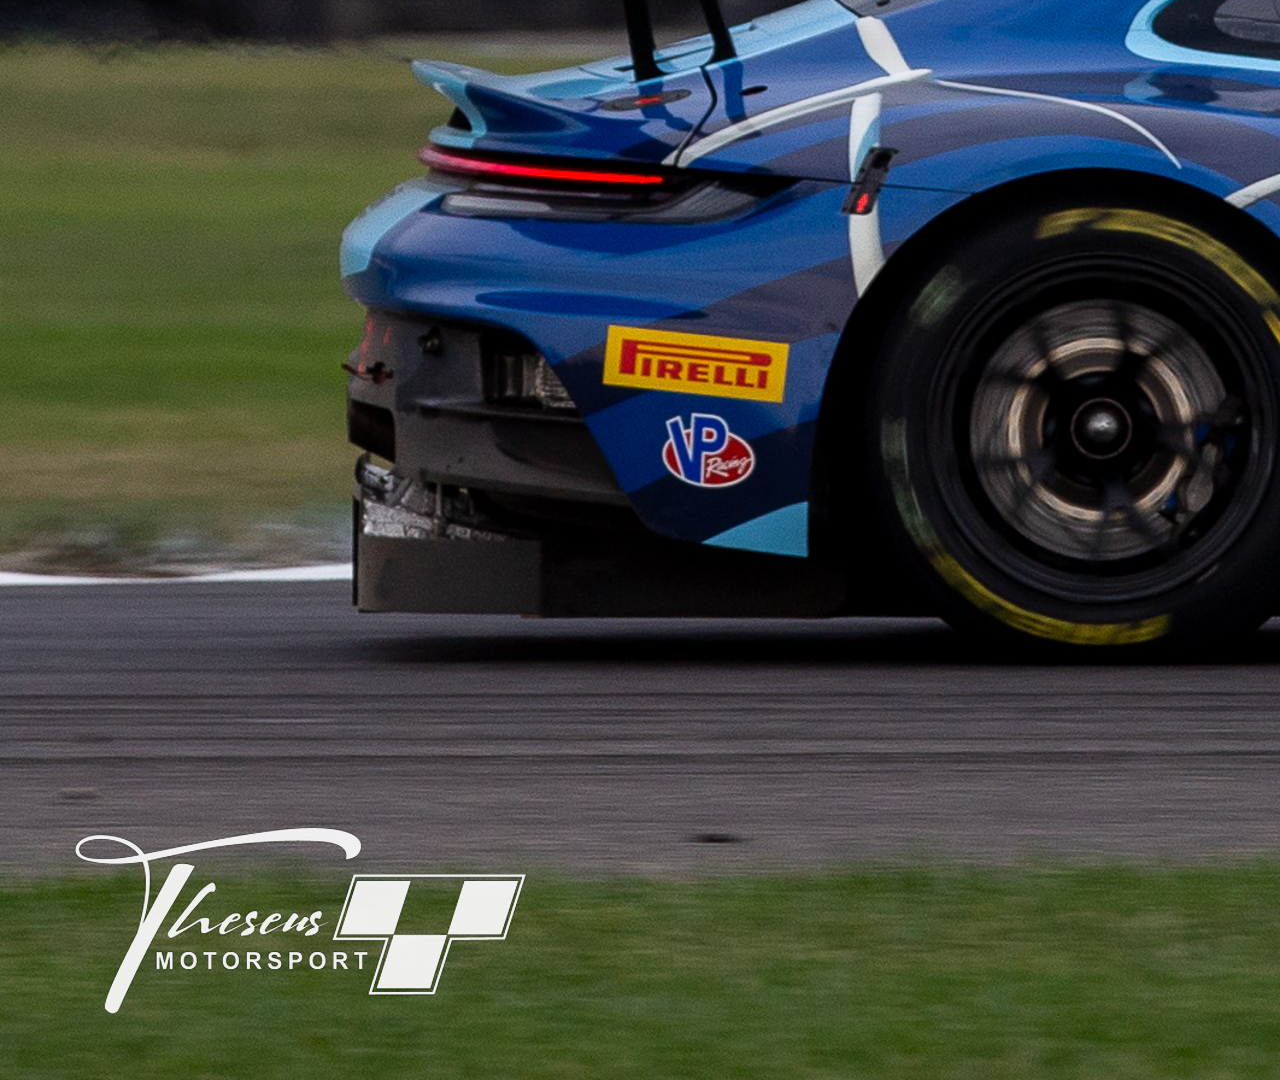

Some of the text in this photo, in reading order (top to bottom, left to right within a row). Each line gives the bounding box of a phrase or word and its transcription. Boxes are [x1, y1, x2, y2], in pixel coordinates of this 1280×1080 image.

[619, 338, 772, 390] PIRELLI
[666, 412, 730, 483] VP
[705, 455, 753, 479] Racing
